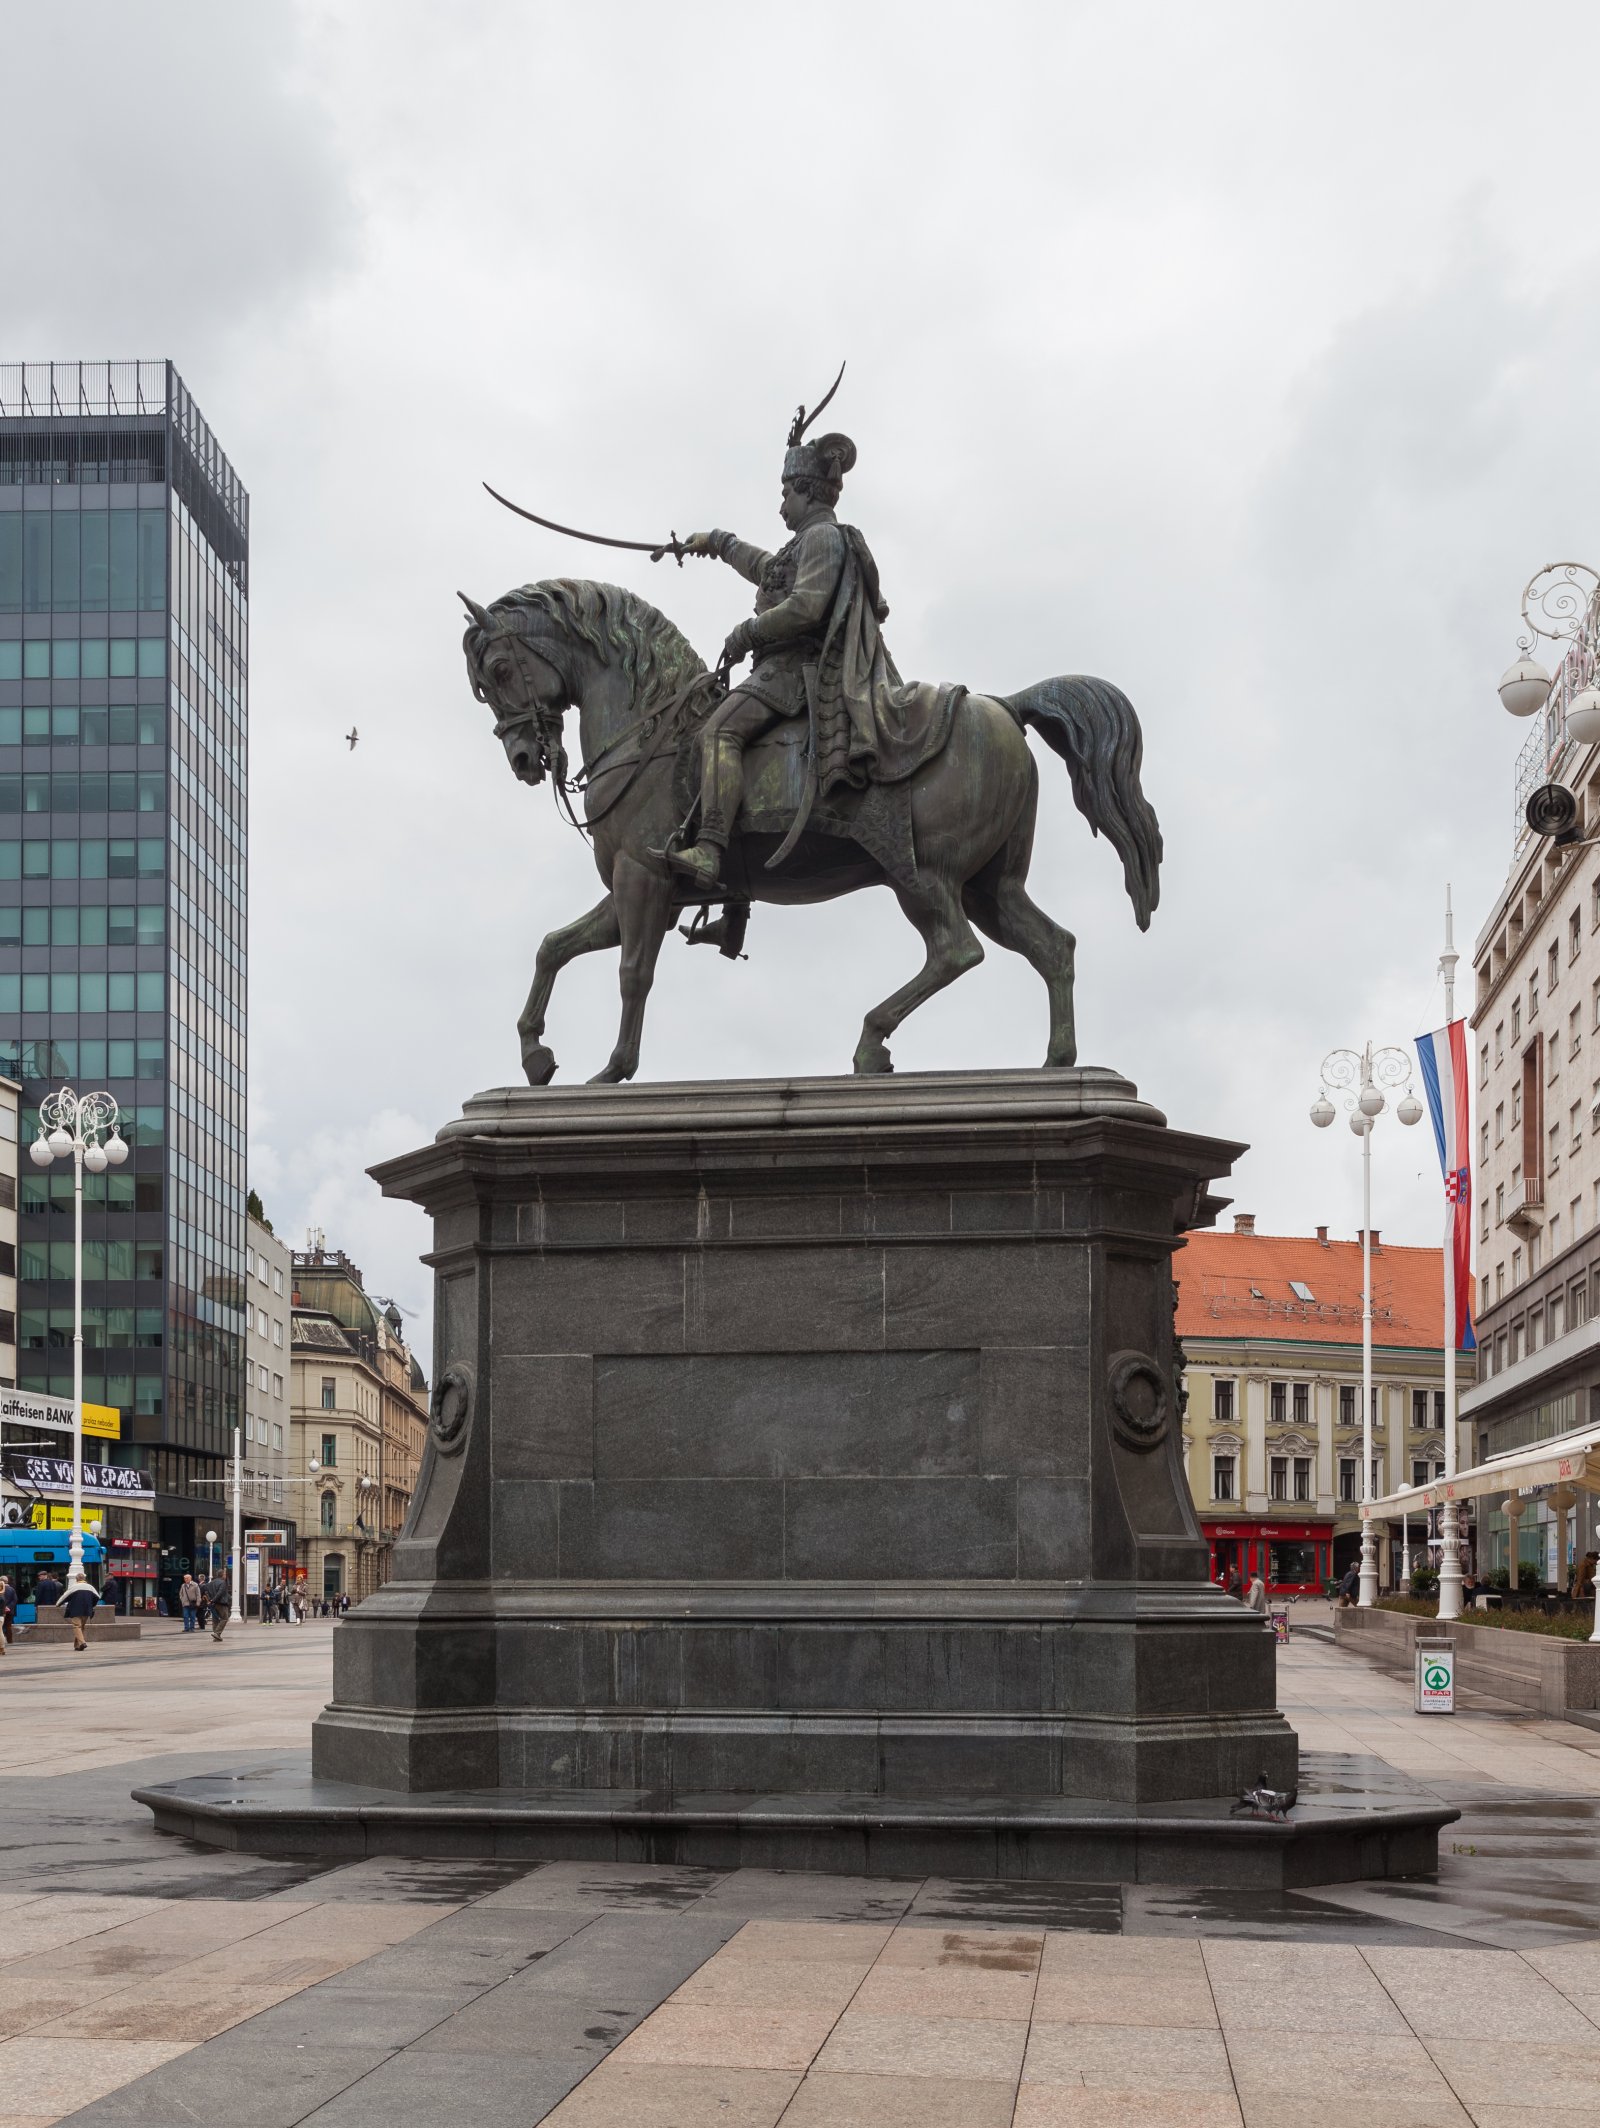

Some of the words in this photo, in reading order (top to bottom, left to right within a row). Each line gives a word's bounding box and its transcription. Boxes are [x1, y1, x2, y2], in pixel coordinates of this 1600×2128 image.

[0, 1399, 44, 1421] aiffeisen
[46, 1406, 74, 1425] BANK
[26, 1458, 52, 1480] SEE
[83, 1465, 97, 1485] IN
[101, 1467, 142, 1489] SPACE!
